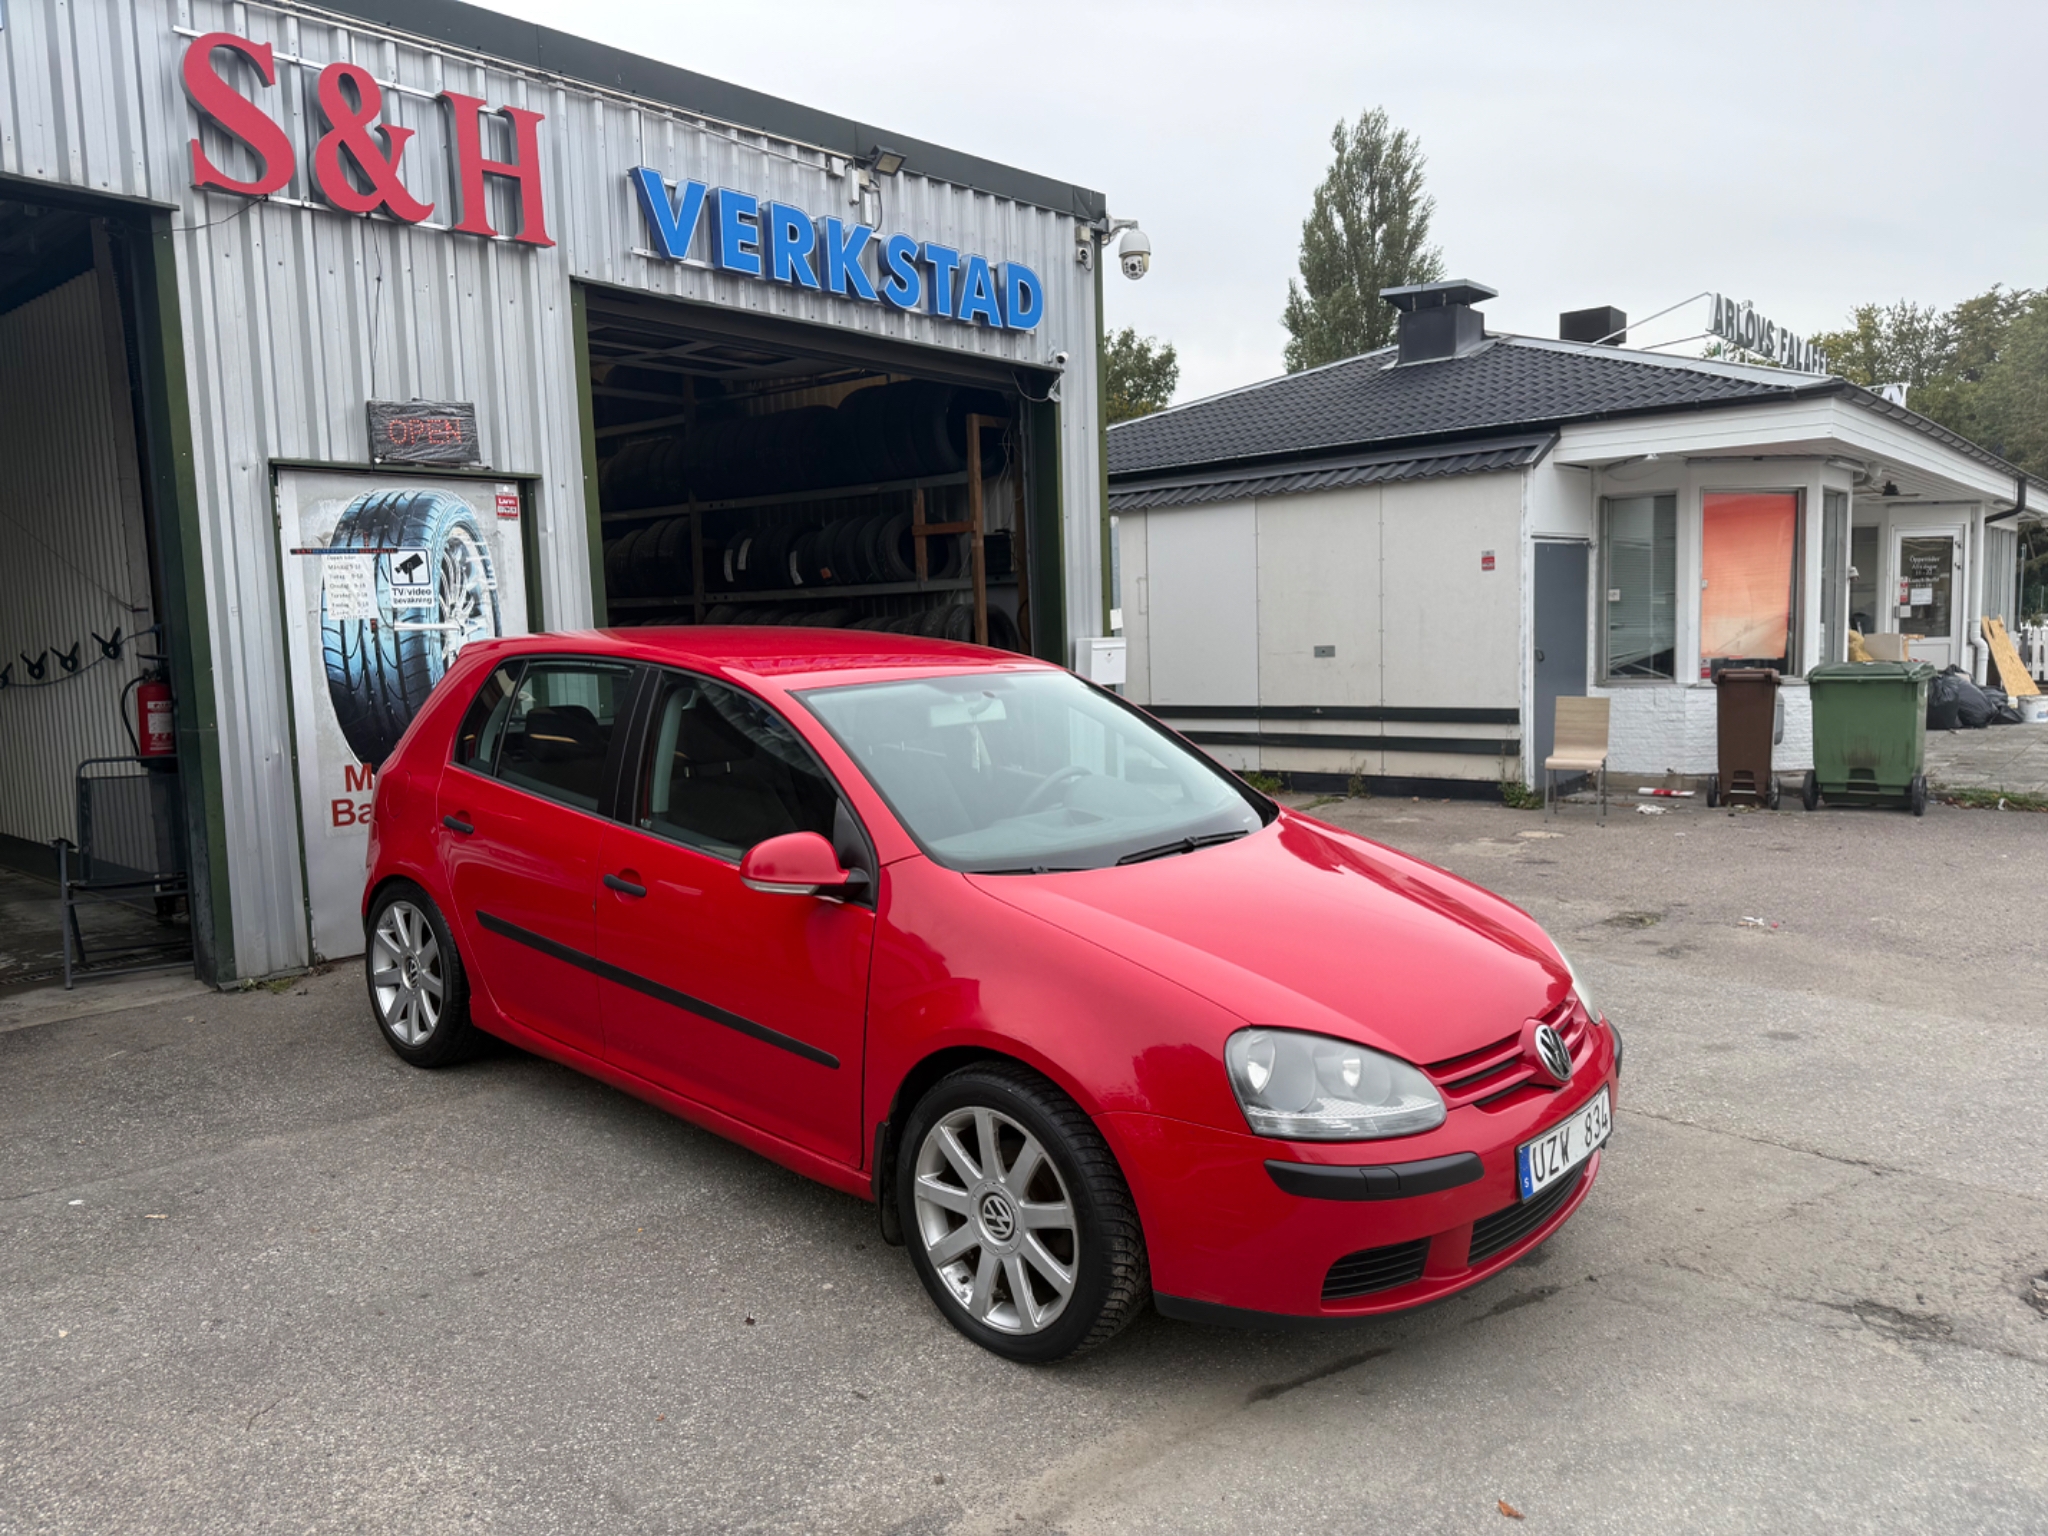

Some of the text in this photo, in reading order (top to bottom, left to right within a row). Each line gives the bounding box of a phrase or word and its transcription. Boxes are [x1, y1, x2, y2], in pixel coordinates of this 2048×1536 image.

[630, 165, 1044, 332] VERKSTAD
[1706, 292, 1776, 358] ARLÖVS
[388, 418, 462, 445] OPEN
[1532, 1098, 1609, 1183] UZW 834
[1523, 1177, 1530, 1189] S
